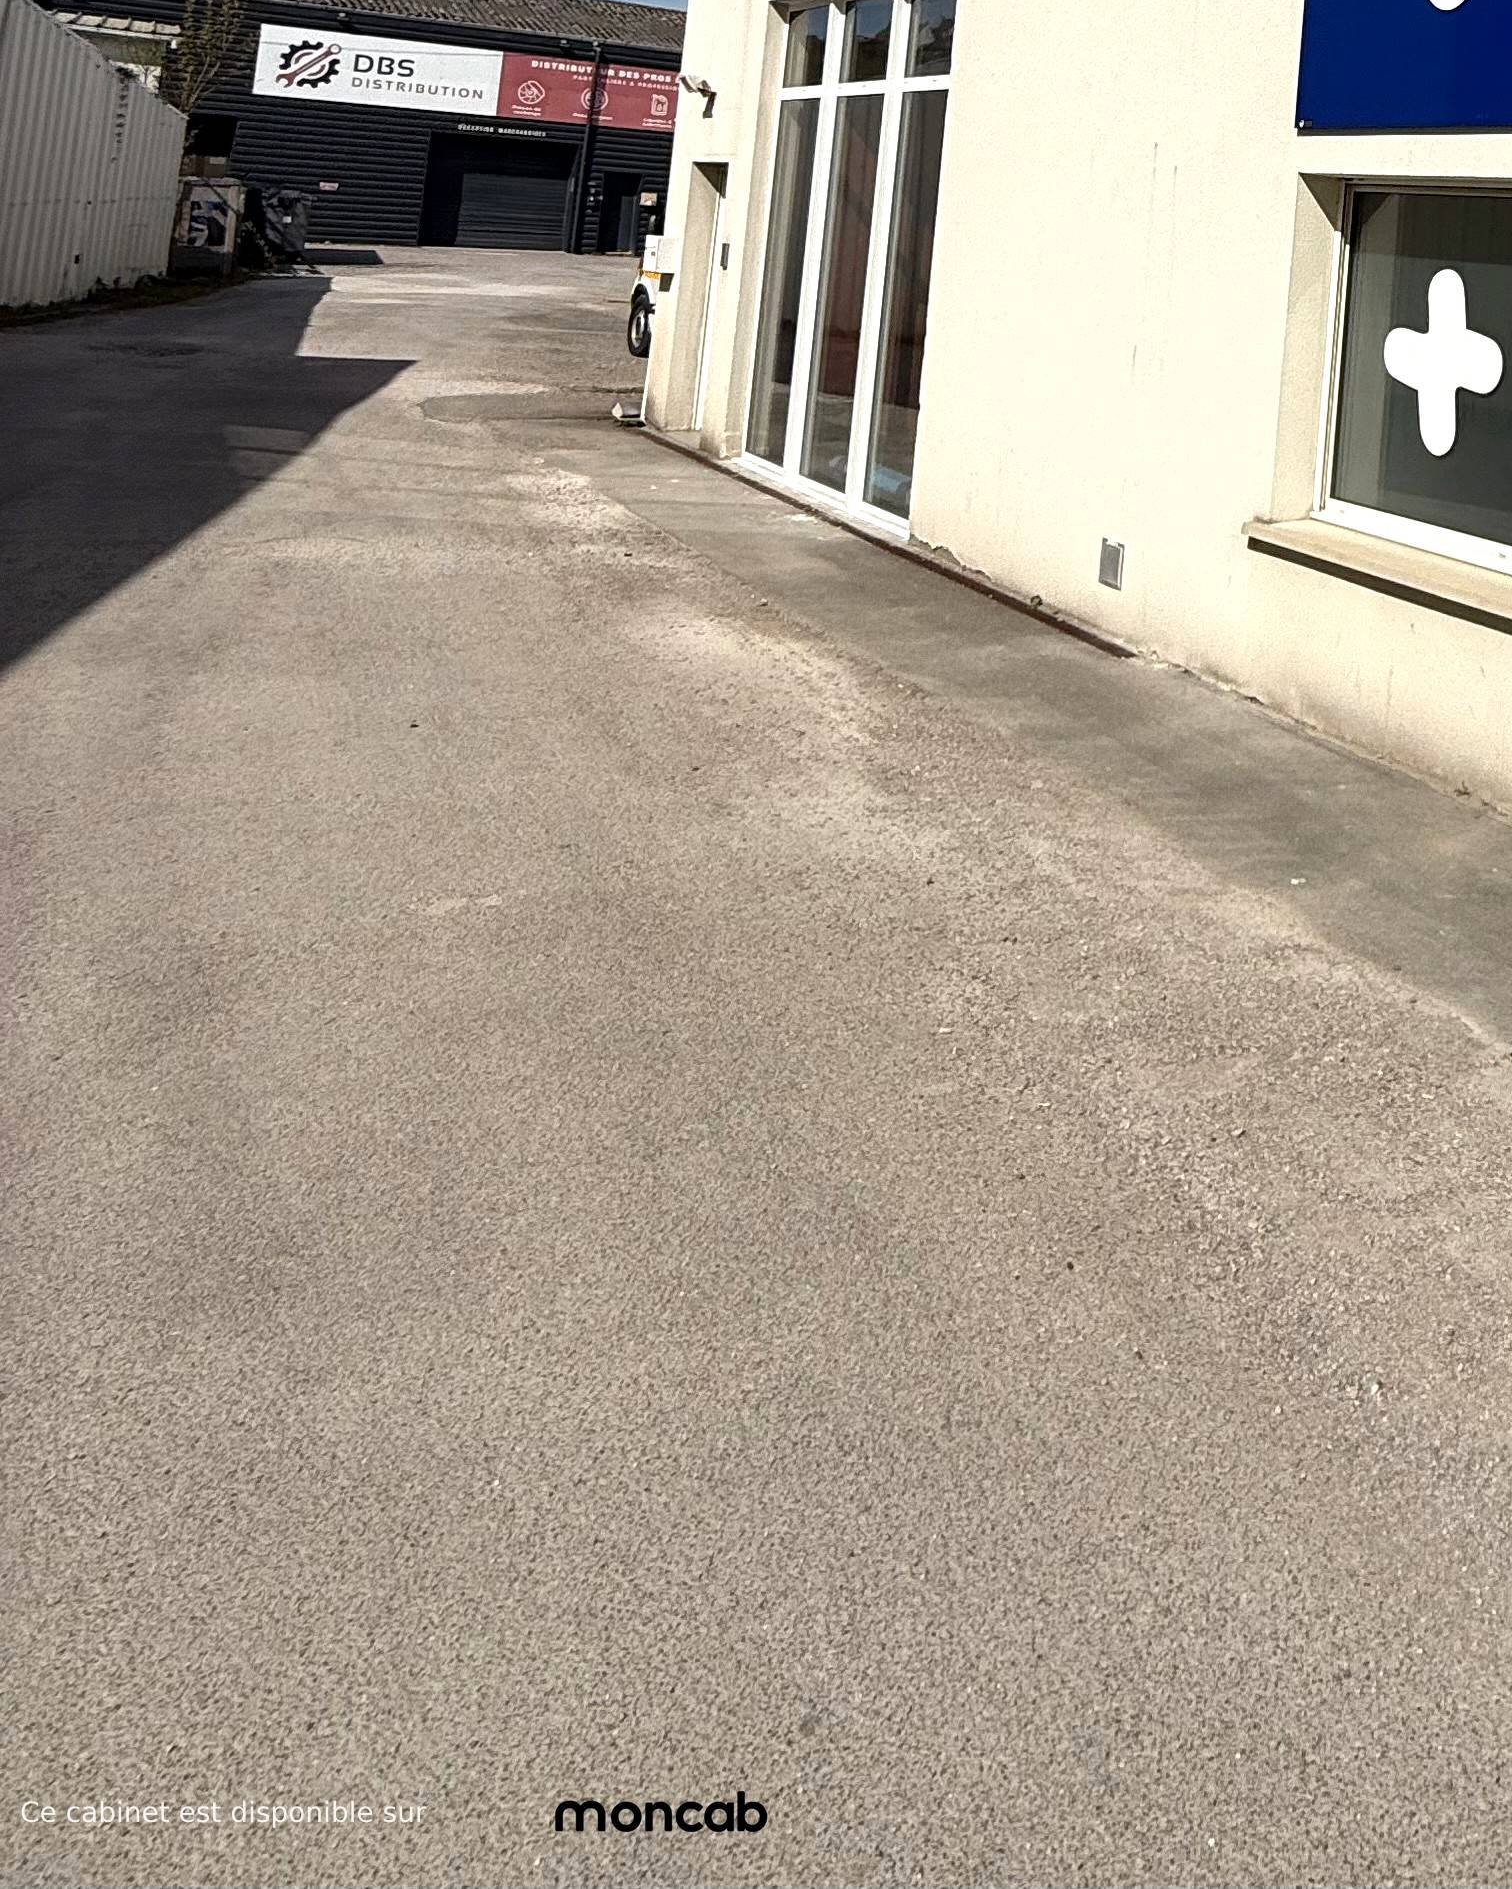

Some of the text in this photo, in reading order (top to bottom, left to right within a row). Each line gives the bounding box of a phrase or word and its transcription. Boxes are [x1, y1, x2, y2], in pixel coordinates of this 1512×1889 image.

[353, 54, 415, 78] DBS
[532, 59, 615, 77] DISTRIBUTUR
[352, 77, 483, 99] DISTRIBUTION
